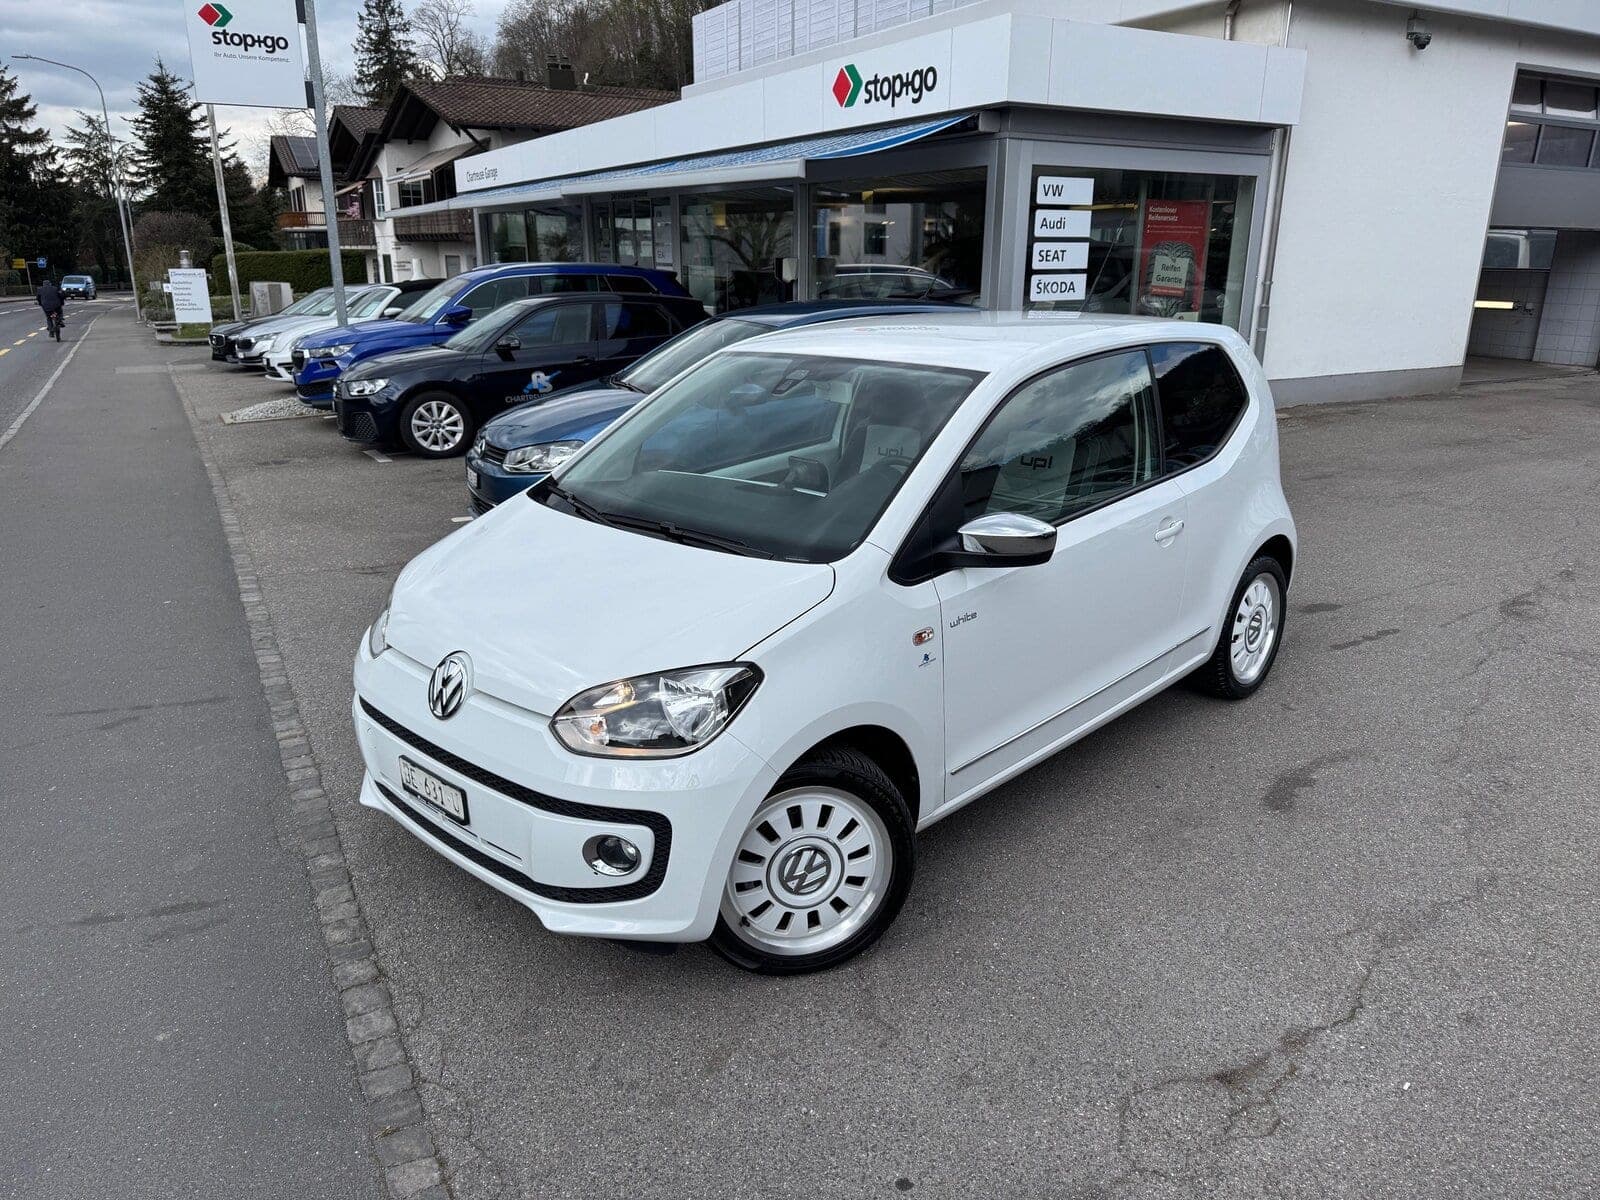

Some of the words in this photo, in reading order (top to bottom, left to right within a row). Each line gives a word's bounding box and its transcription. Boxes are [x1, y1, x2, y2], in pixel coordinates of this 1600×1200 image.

[211, 28, 289, 54] stop+go
[864, 65, 938, 108] stop+go
[485, 167, 498, 181] Garage
[1042, 183, 1064, 198] VW
[1039, 216, 1067, 230] Audi
[1037, 249, 1067, 263] SEAT
[1160, 263, 1181, 272] Reifen
[1155, 274, 1183, 284] Garantie
[1035, 279, 1076, 295] ŠKODA
[1019, 454, 1054, 471] up!
[949, 611, 978, 628] white
[424, 777, 445, 806] 631
